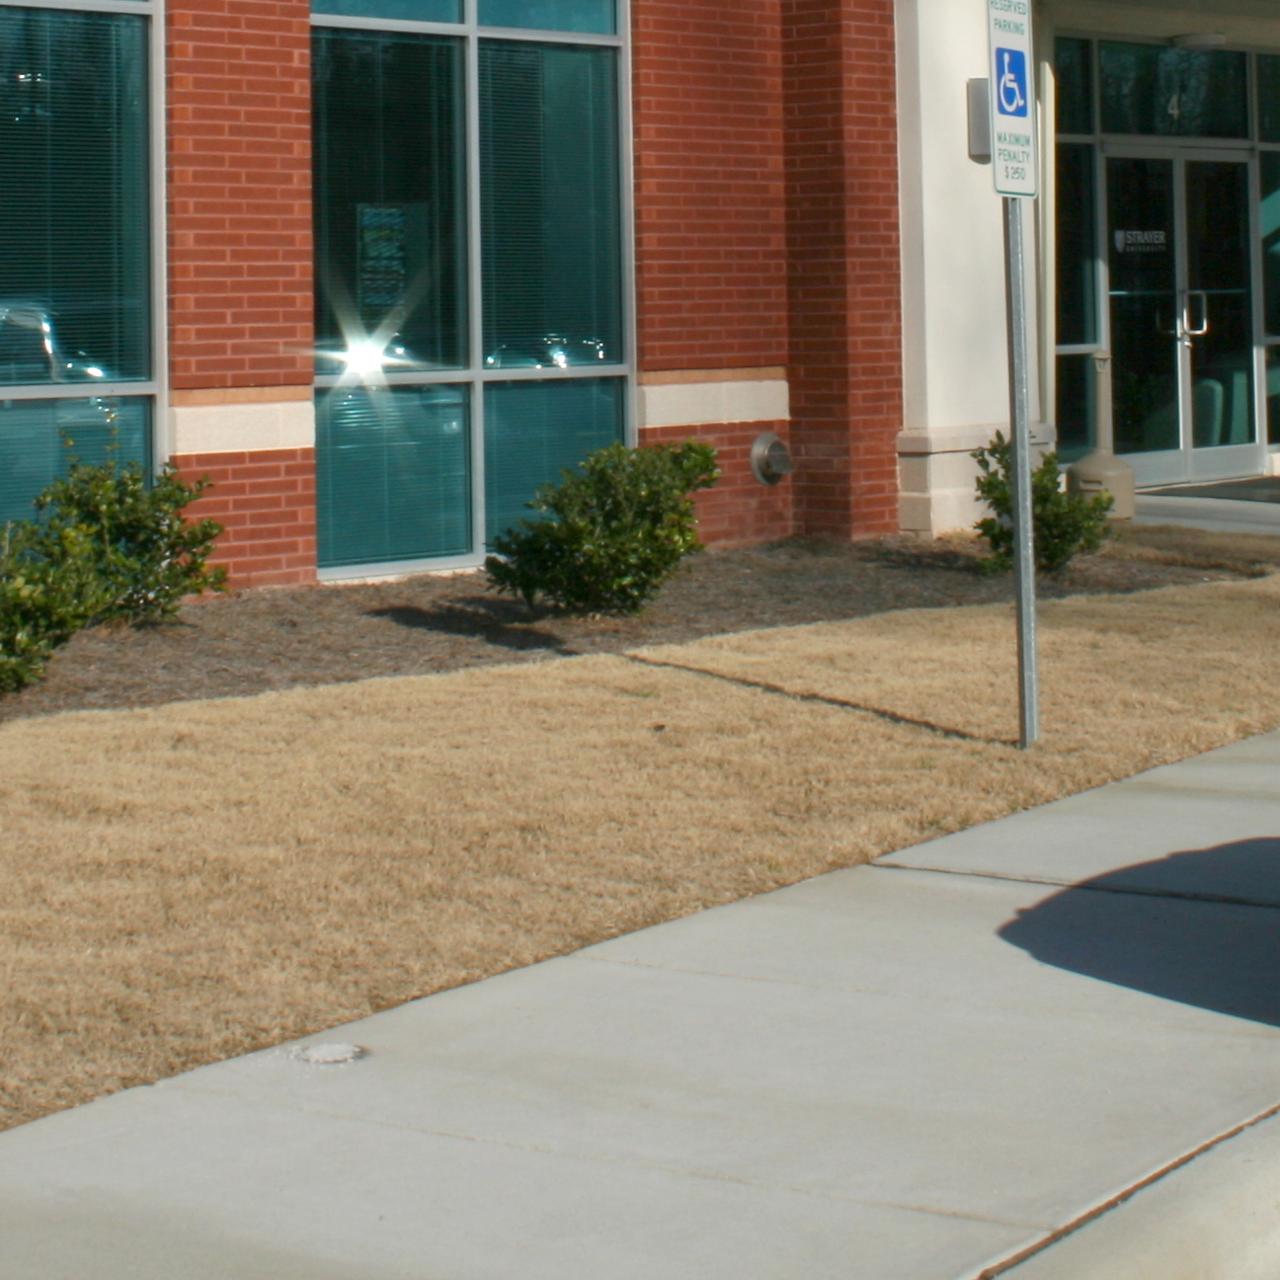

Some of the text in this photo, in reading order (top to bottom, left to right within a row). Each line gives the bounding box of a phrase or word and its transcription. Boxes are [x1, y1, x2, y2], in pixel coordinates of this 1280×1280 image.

[993, 18, 1025, 36] PARKING
[997, 131, 1031, 146] MAXIMUM
[998, 148, 1030, 163] PENALTY
[1126, 230, 1166, 244] STRAYER
